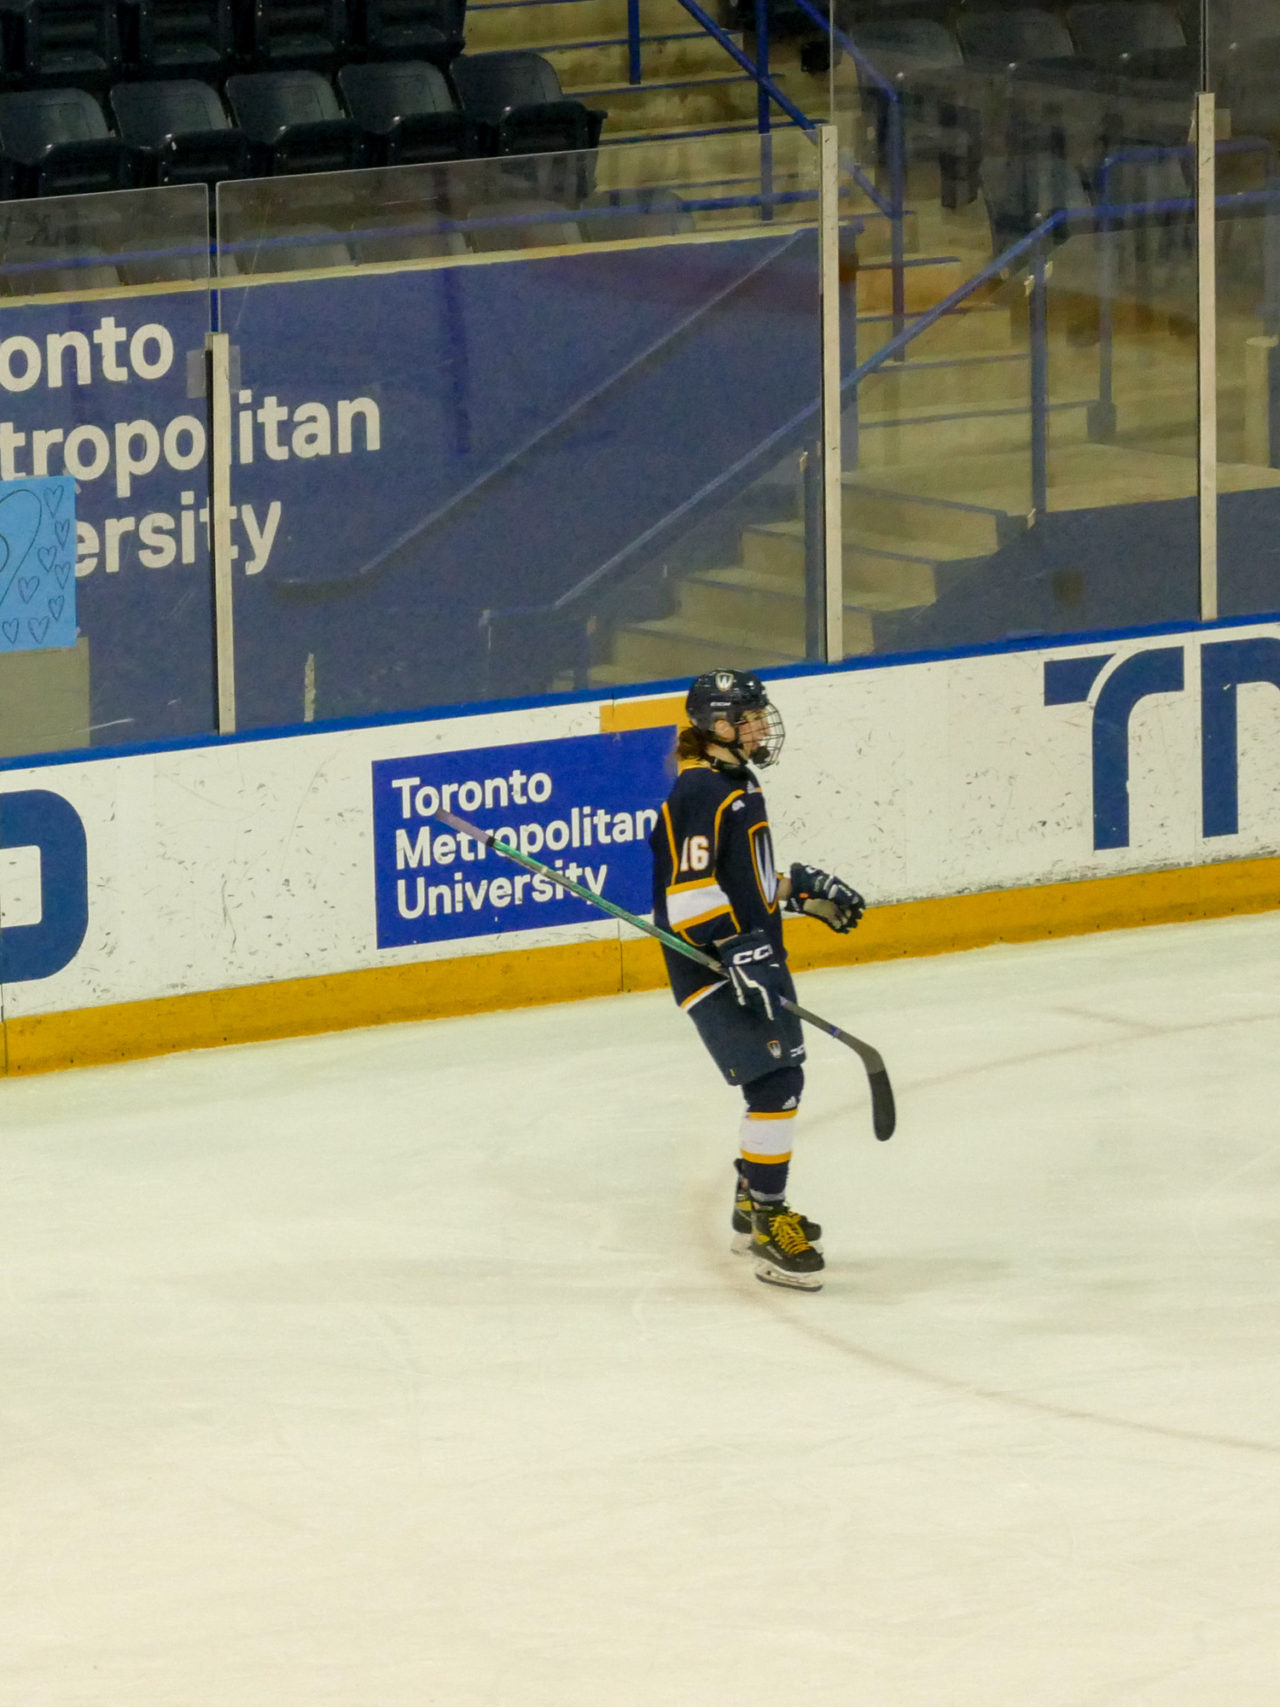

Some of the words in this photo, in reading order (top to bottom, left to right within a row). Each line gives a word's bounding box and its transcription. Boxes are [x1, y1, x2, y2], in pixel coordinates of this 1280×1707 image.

[0, 389, 381, 498] tropoitan
[392, 770, 552, 819] Toronto
[395, 806, 658, 870] Metropolitan
[680, 834, 710, 872] 16
[397, 860, 608, 920] University
[733, 944, 773, 965] CC
